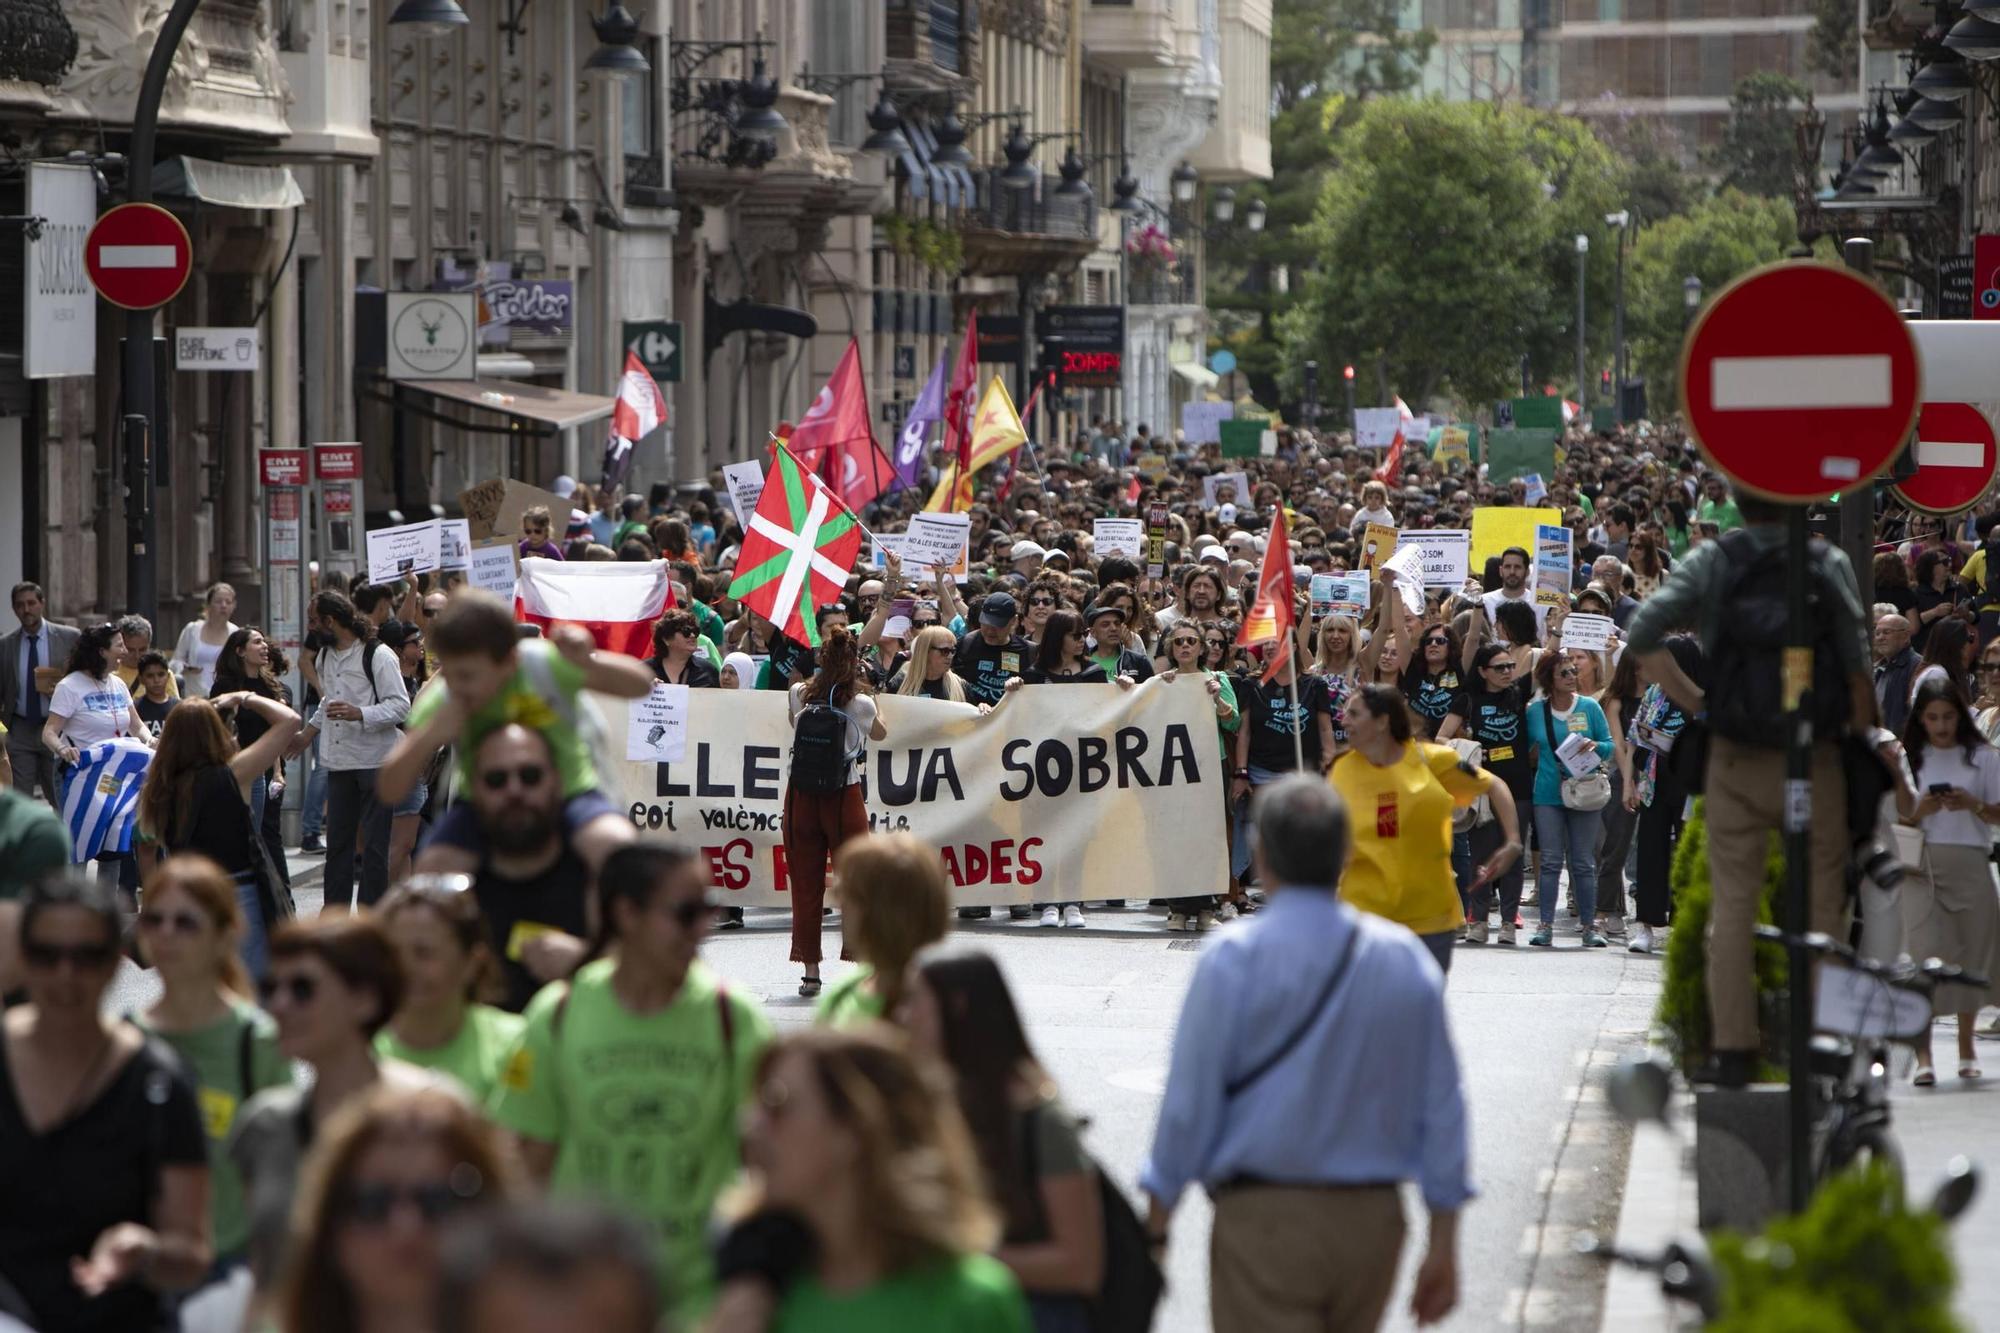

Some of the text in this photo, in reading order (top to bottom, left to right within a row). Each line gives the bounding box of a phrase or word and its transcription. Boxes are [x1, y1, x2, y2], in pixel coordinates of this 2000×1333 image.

[488, 283, 568, 320] Folder
[266, 458, 300, 466] EMT
[320, 453, 353, 461] EMT
[482, 556, 510, 567] MESTRES
[1539, 560, 1569, 569] PRESENCIAL
[1423, 564, 1454, 572] LLABLES!
[978, 672, 1006, 686] LLENG
[656, 723, 1202, 806] LLEUA SOBRA
[629, 800, 677, 832] eoi
[699, 804, 784, 832] valènc
[700, 837, 754, 890] ES
